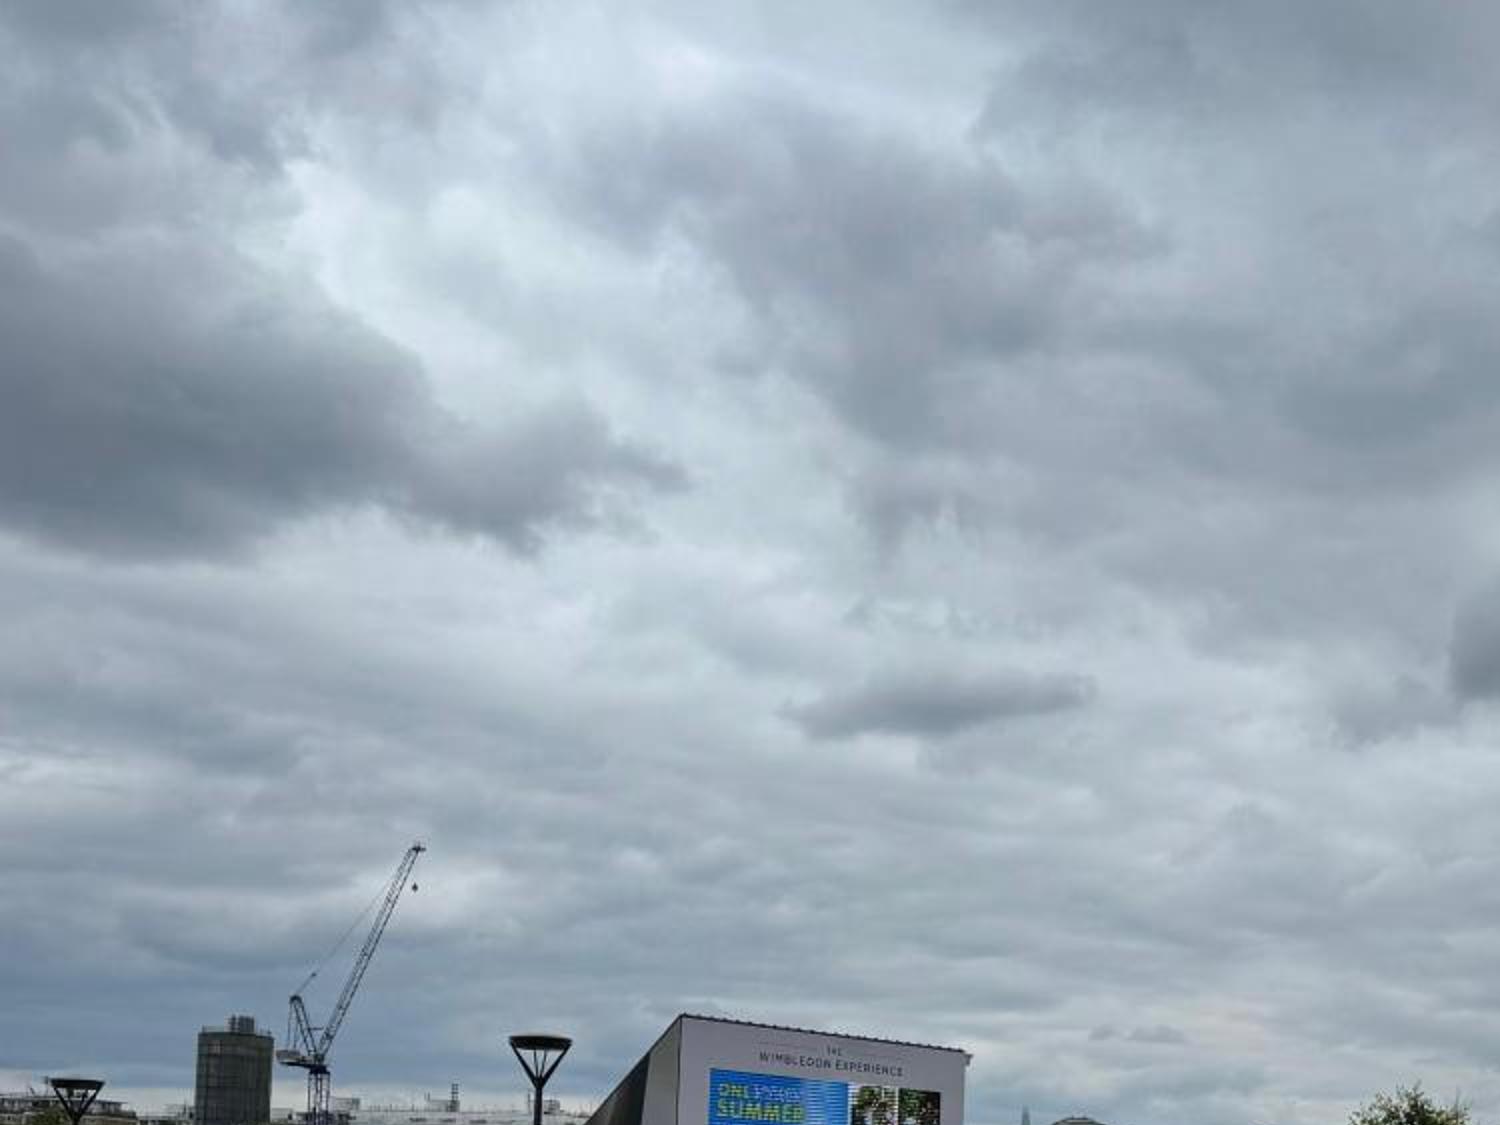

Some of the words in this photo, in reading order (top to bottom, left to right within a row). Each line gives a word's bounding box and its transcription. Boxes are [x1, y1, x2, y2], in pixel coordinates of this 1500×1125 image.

[758, 1051, 832, 1069] WIMBLEDON
[835, 1059, 903, 1077] EXPERIENCE
[826, 1045, 842, 1057] THE
[716, 1098, 806, 1124] SUMMER
